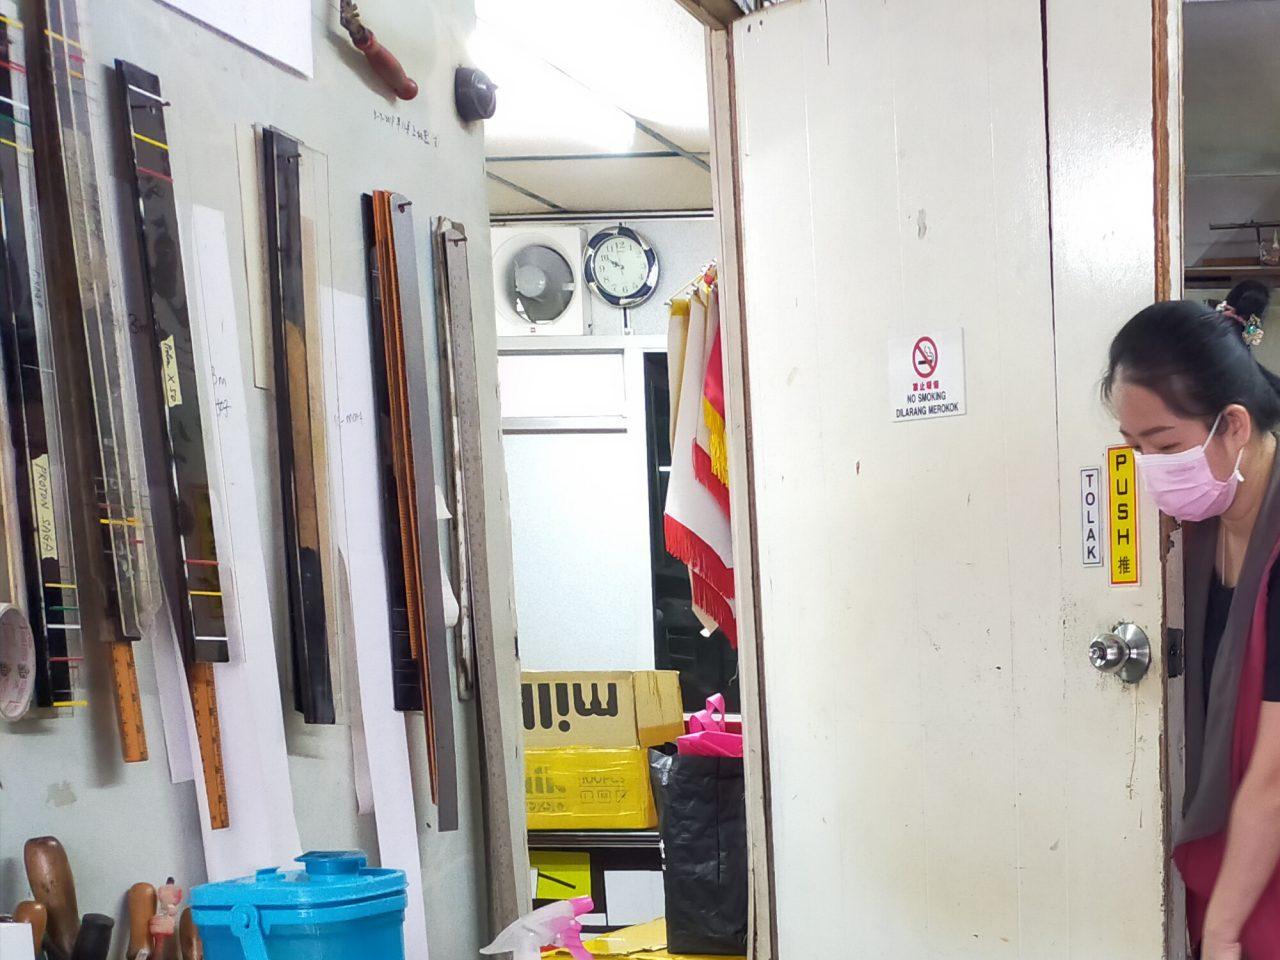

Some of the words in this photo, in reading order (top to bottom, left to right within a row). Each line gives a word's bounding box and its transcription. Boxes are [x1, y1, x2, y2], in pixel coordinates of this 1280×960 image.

[907, 393, 916, 404] NO
[918, 390, 947, 403] SMOKING
[896, 405, 927, 418] DILARANG
[928, 401, 959, 415] MEROKOK
[1115, 453, 1129, 545] PUSH
[1085, 473, 1096, 560] TOLAK
[1117, 556, 1131, 575] 推
